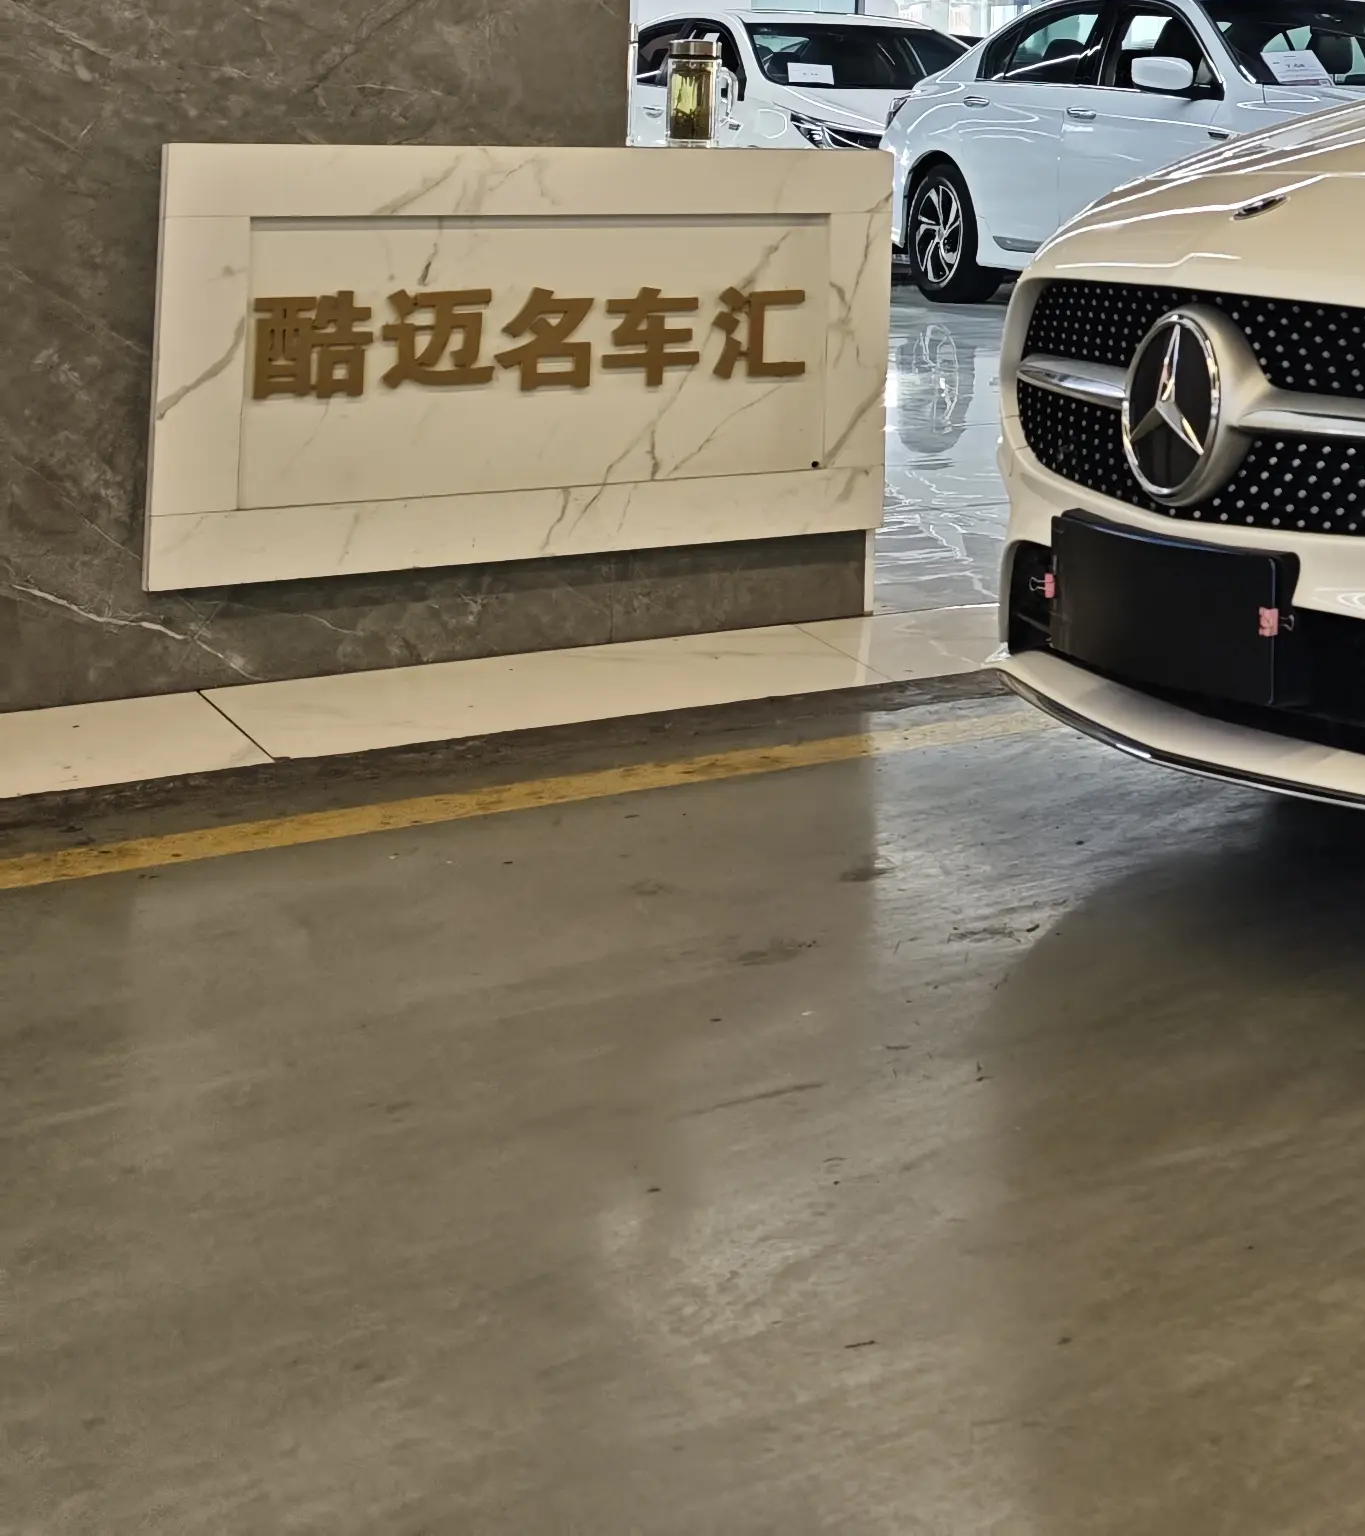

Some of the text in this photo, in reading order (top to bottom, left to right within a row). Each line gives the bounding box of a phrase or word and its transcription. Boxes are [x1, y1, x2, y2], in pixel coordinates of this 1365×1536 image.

[252, 286, 806, 400] 酷迈名车汇
